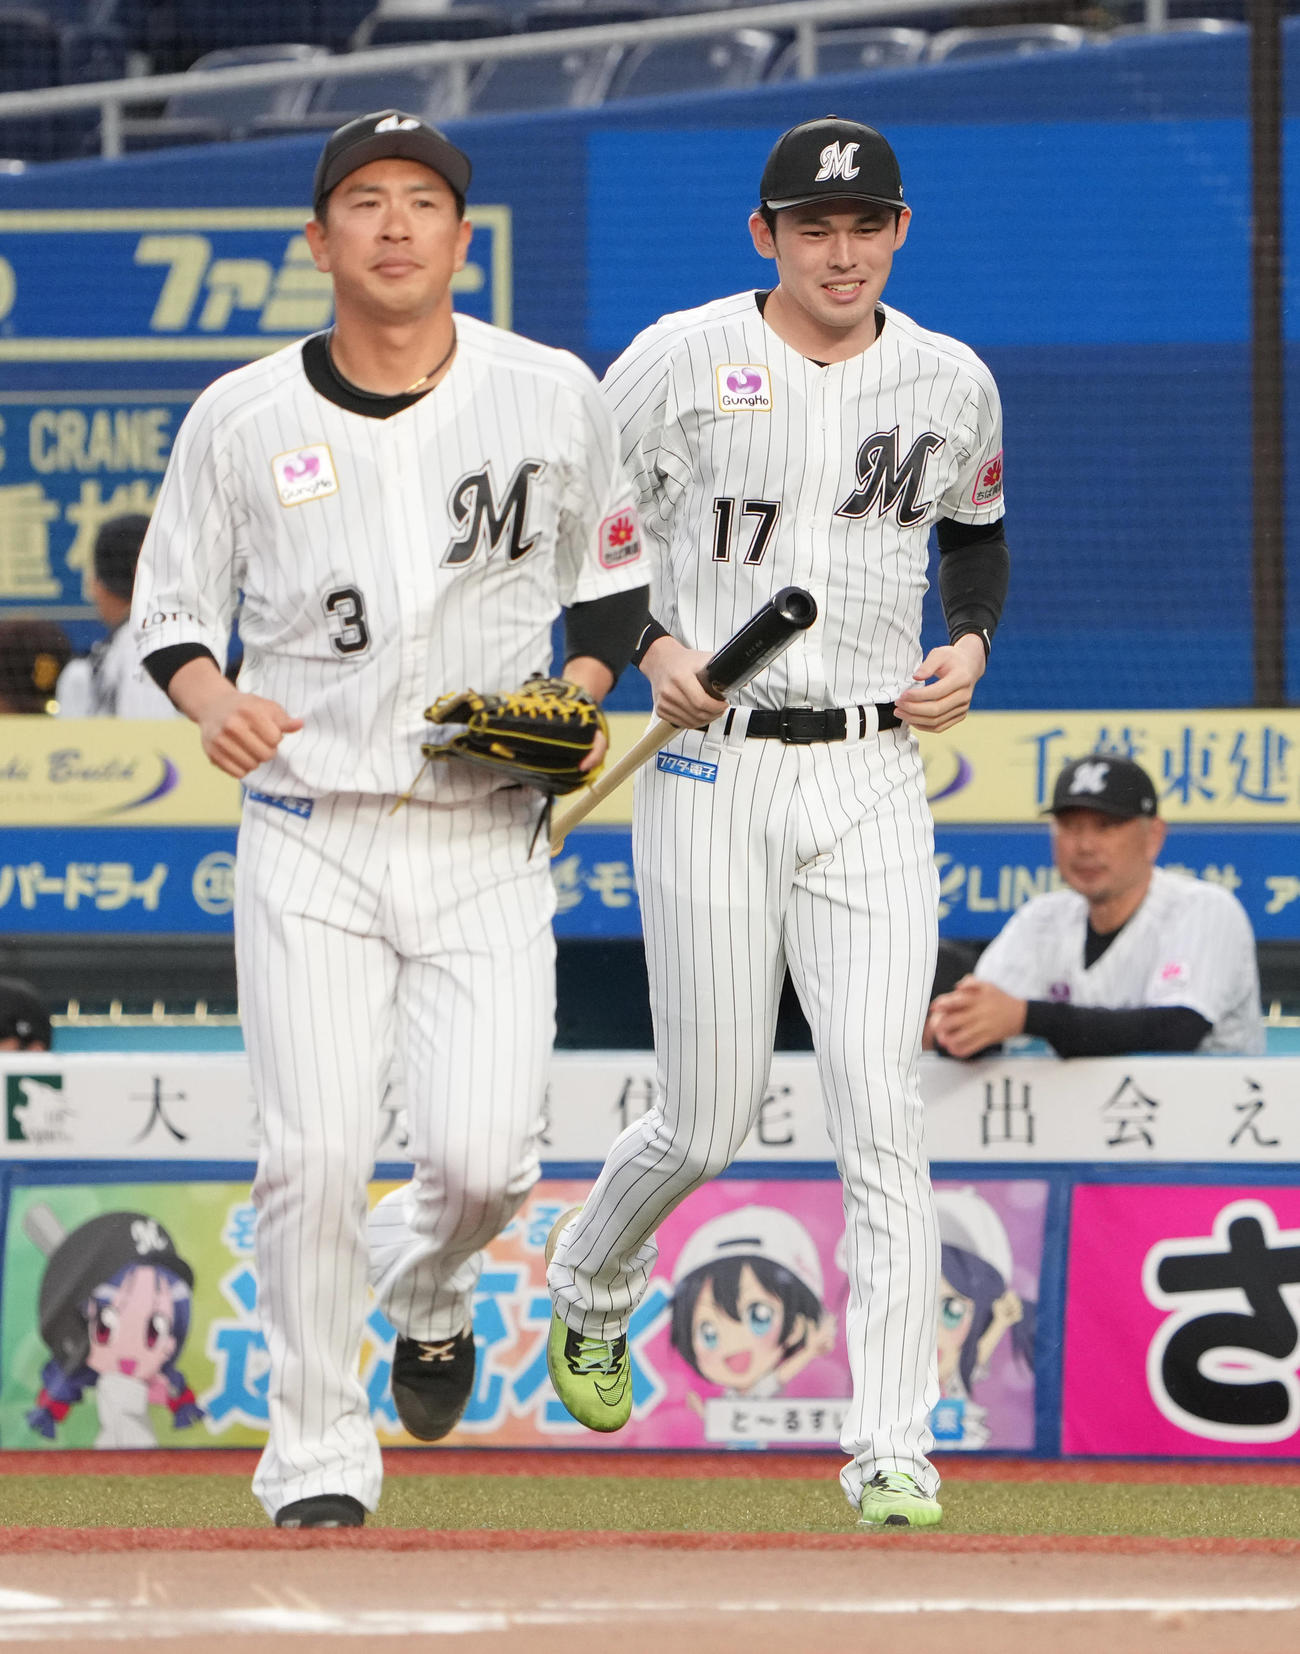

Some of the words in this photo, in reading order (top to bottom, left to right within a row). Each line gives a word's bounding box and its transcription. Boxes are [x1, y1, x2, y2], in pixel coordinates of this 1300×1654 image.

[814, 140, 860, 183] M
[722, 394, 769, 407] GungHo
[29, 408, 171, 474] CRANE
[836, 424, 945, 528] M
[440, 458, 546, 569] M
[711, 497, 781, 565] 17
[323, 585, 371, 660] 3
[1156, 1214, 1300, 1427] さ
